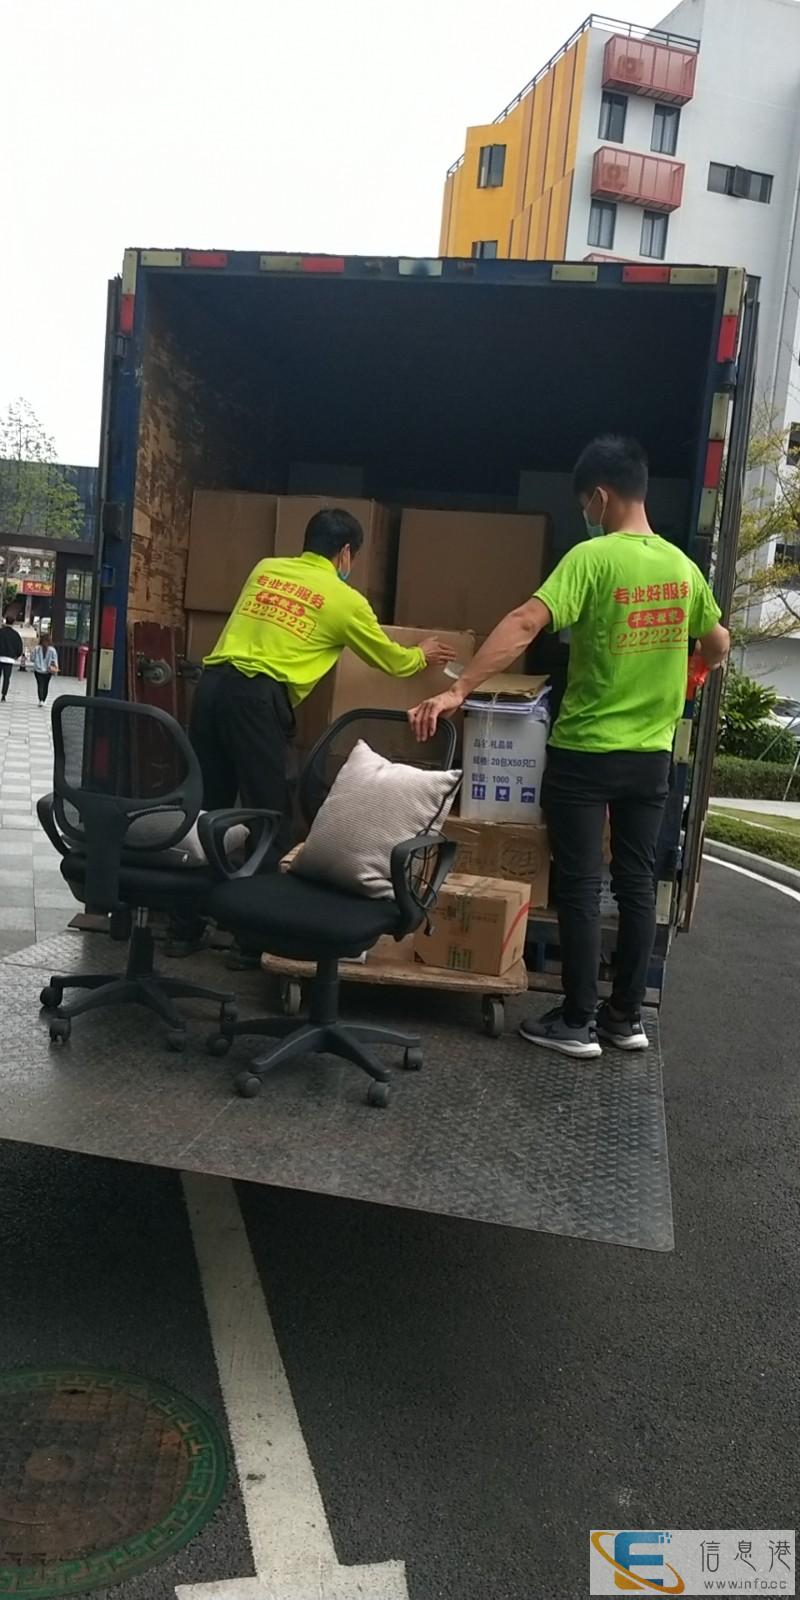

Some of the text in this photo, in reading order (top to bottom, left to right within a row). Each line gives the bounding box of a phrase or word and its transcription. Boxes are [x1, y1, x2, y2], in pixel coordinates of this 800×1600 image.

[256, 574, 325, 610] 专业好服务
[613, 581, 689, 605] 专业好服务
[242, 600, 306, 634] 2222222
